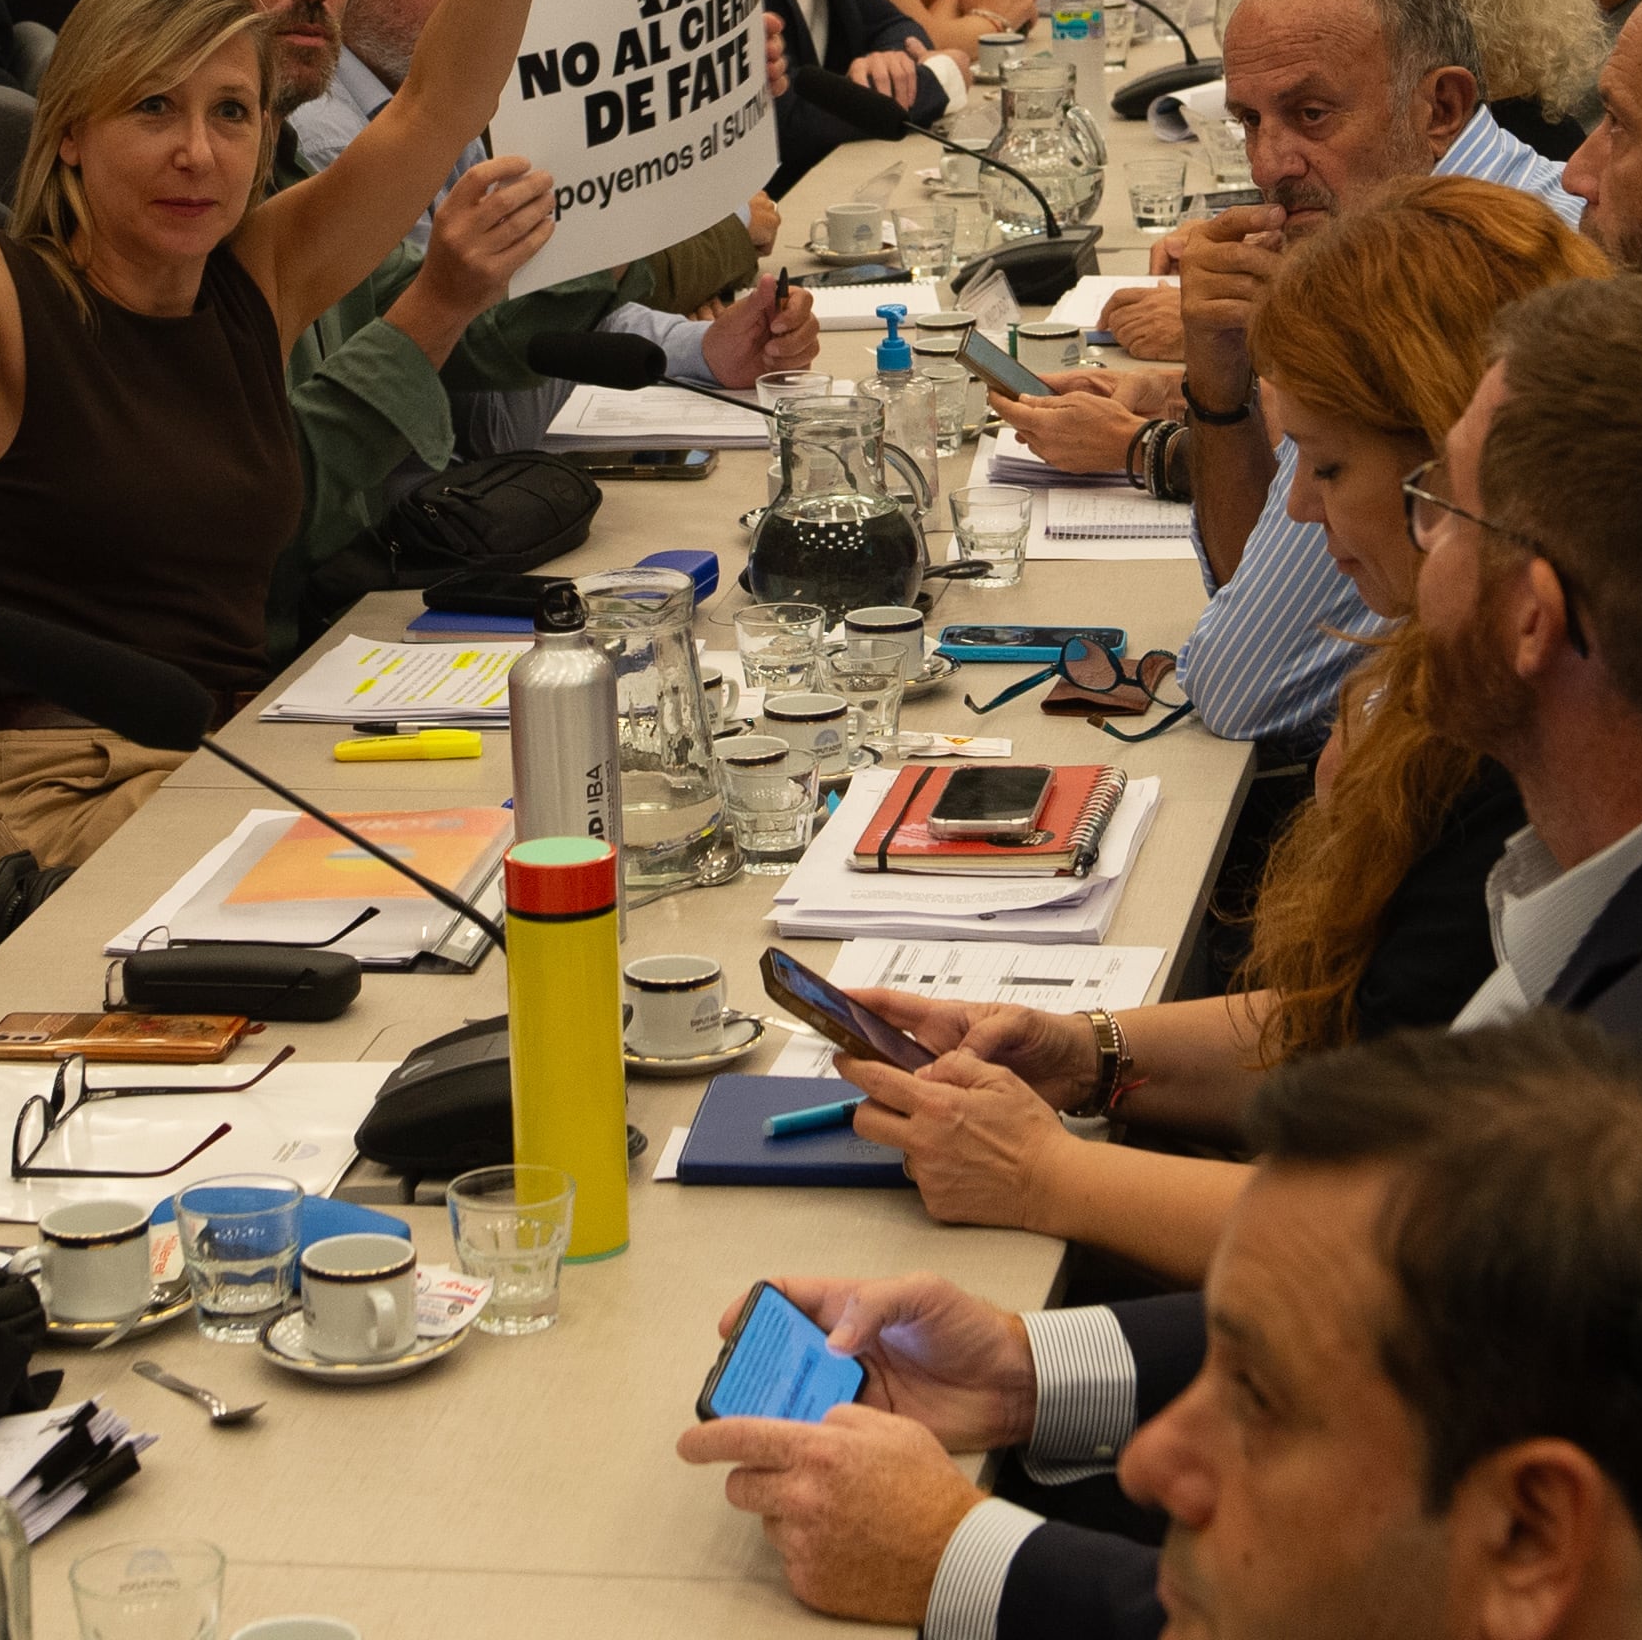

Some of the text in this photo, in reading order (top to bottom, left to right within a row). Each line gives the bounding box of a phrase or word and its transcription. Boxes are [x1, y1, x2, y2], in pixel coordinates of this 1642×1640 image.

[518, 41, 600, 100] NO
[613, 21, 670, 77] AL
[584, 29, 750, 148] DE FATE
[553, 144, 694, 221] poyemos
[699, 122, 718, 161] al
